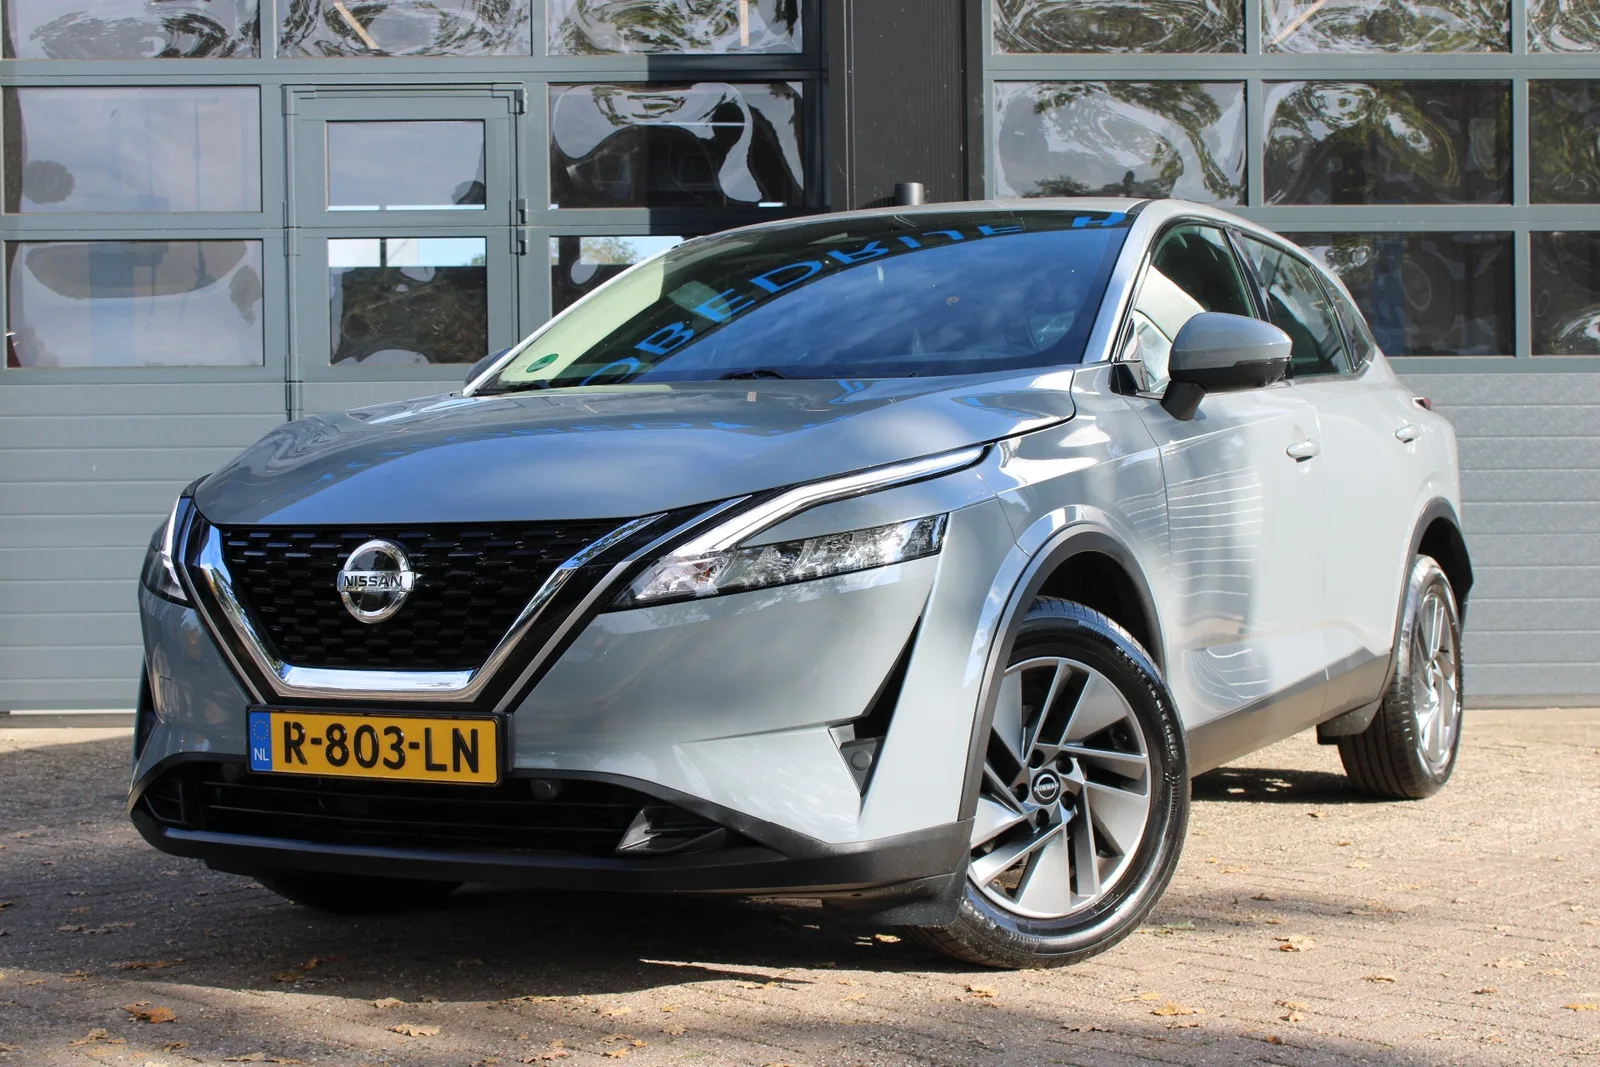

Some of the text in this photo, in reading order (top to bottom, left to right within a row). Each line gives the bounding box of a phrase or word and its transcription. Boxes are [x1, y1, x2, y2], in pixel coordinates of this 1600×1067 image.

[343, 575, 404, 588] NISSAN
[253, 747, 270, 762] NL
[283, 720, 480, 774] R-803-LN
